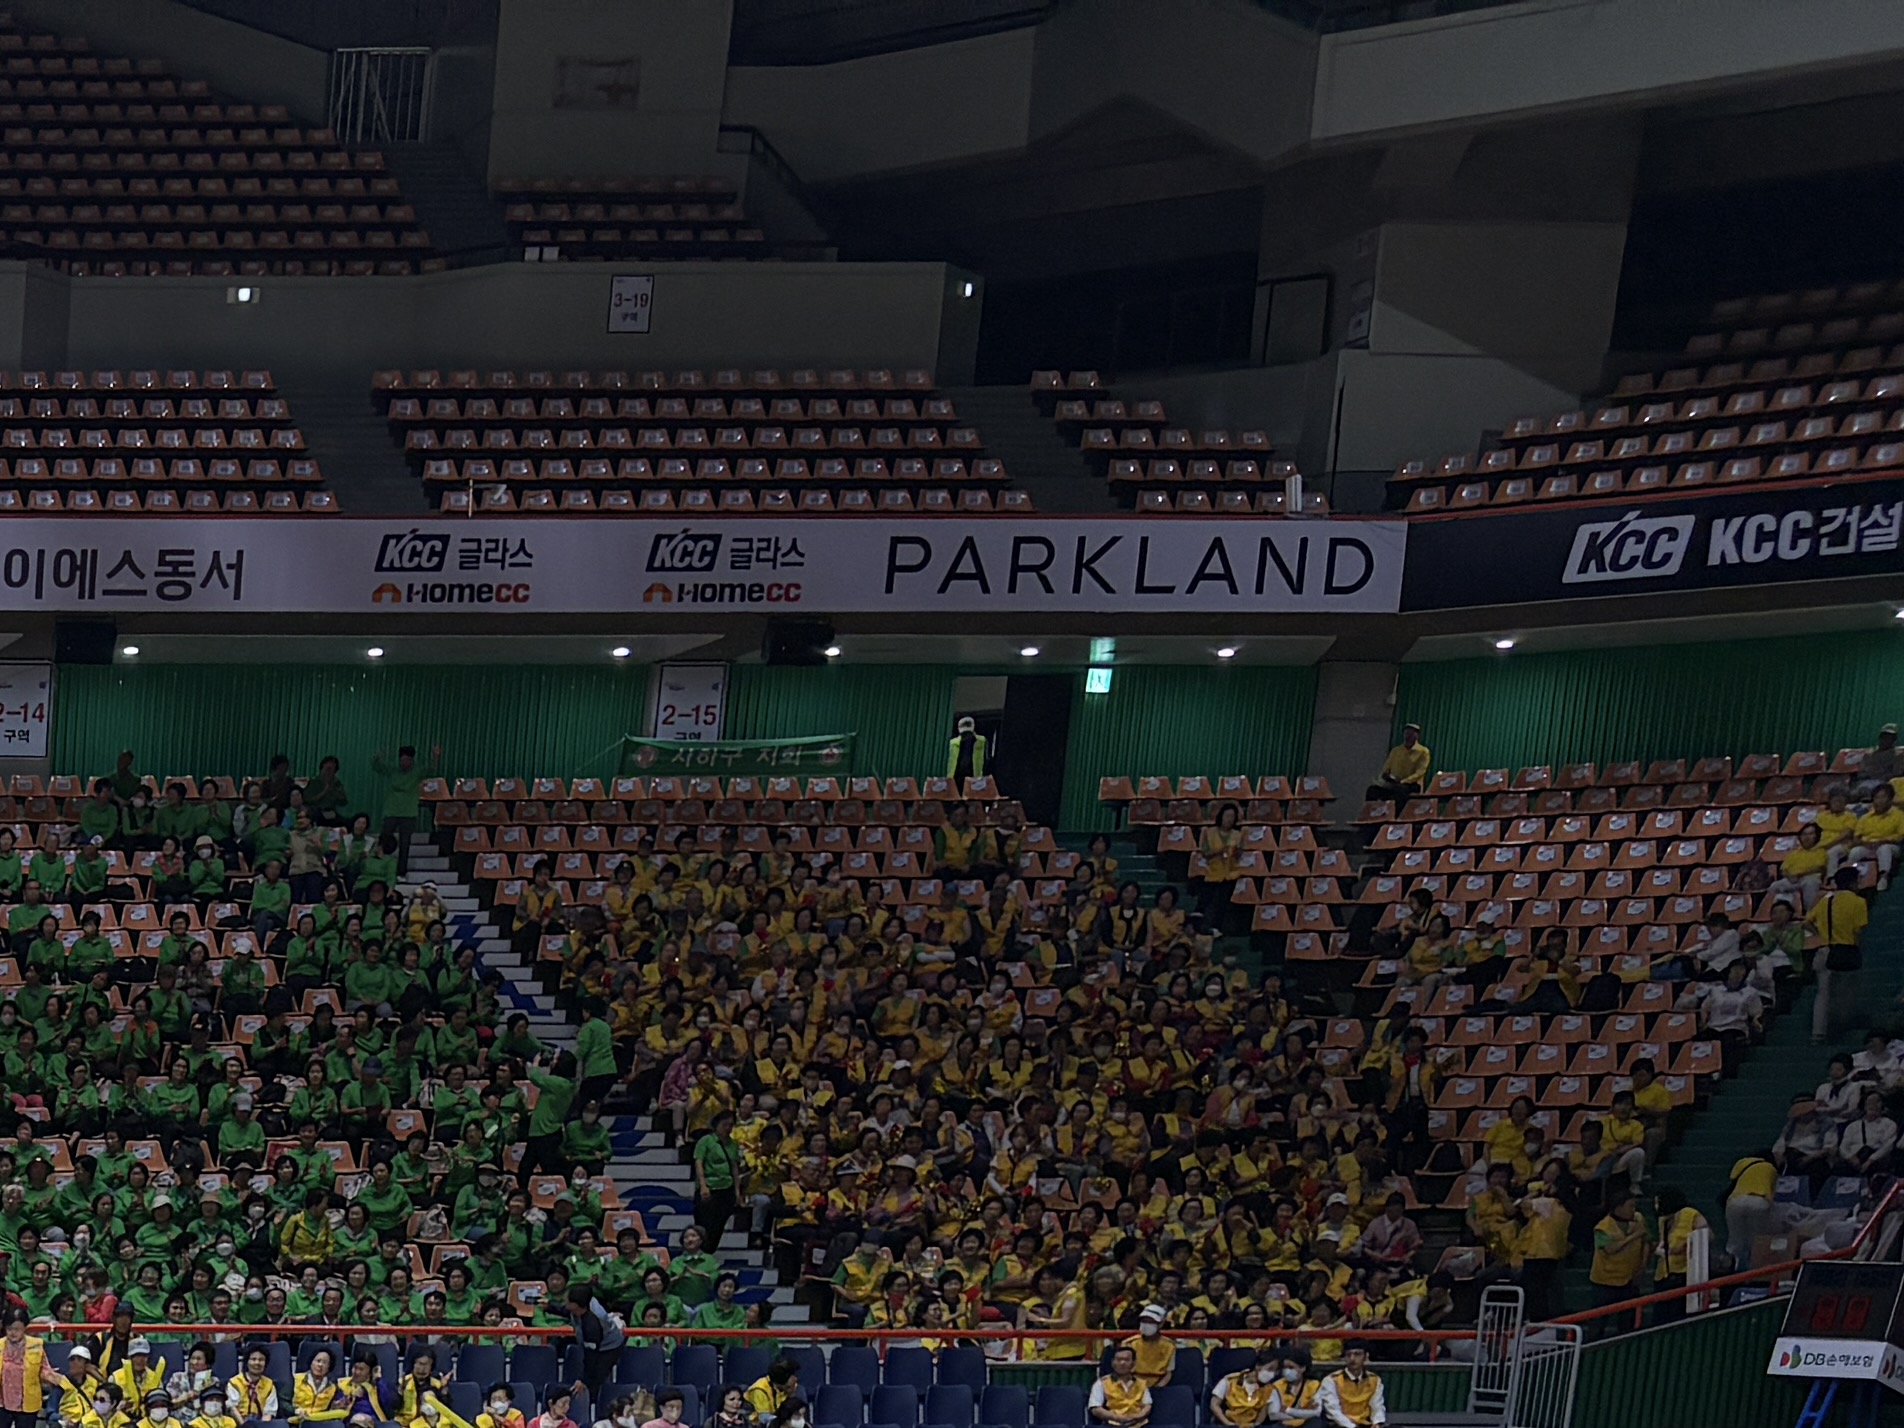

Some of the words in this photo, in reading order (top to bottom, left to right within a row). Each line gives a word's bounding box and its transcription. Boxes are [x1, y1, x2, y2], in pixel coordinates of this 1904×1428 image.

[613, 292, 649, 308] 3-19
[379, 529, 446, 571] KCC
[458, 536, 534, 571] 글라스
[650, 529, 717, 571] KCC
[729, 536, 806, 571] 글라스
[1576, 509, 1680, 577] KCC
[1706, 501, 1904, 567] KCC건설
[884, 535, 1376, 596] PARKLAND
[661, 704, 718, 727] 2-15
